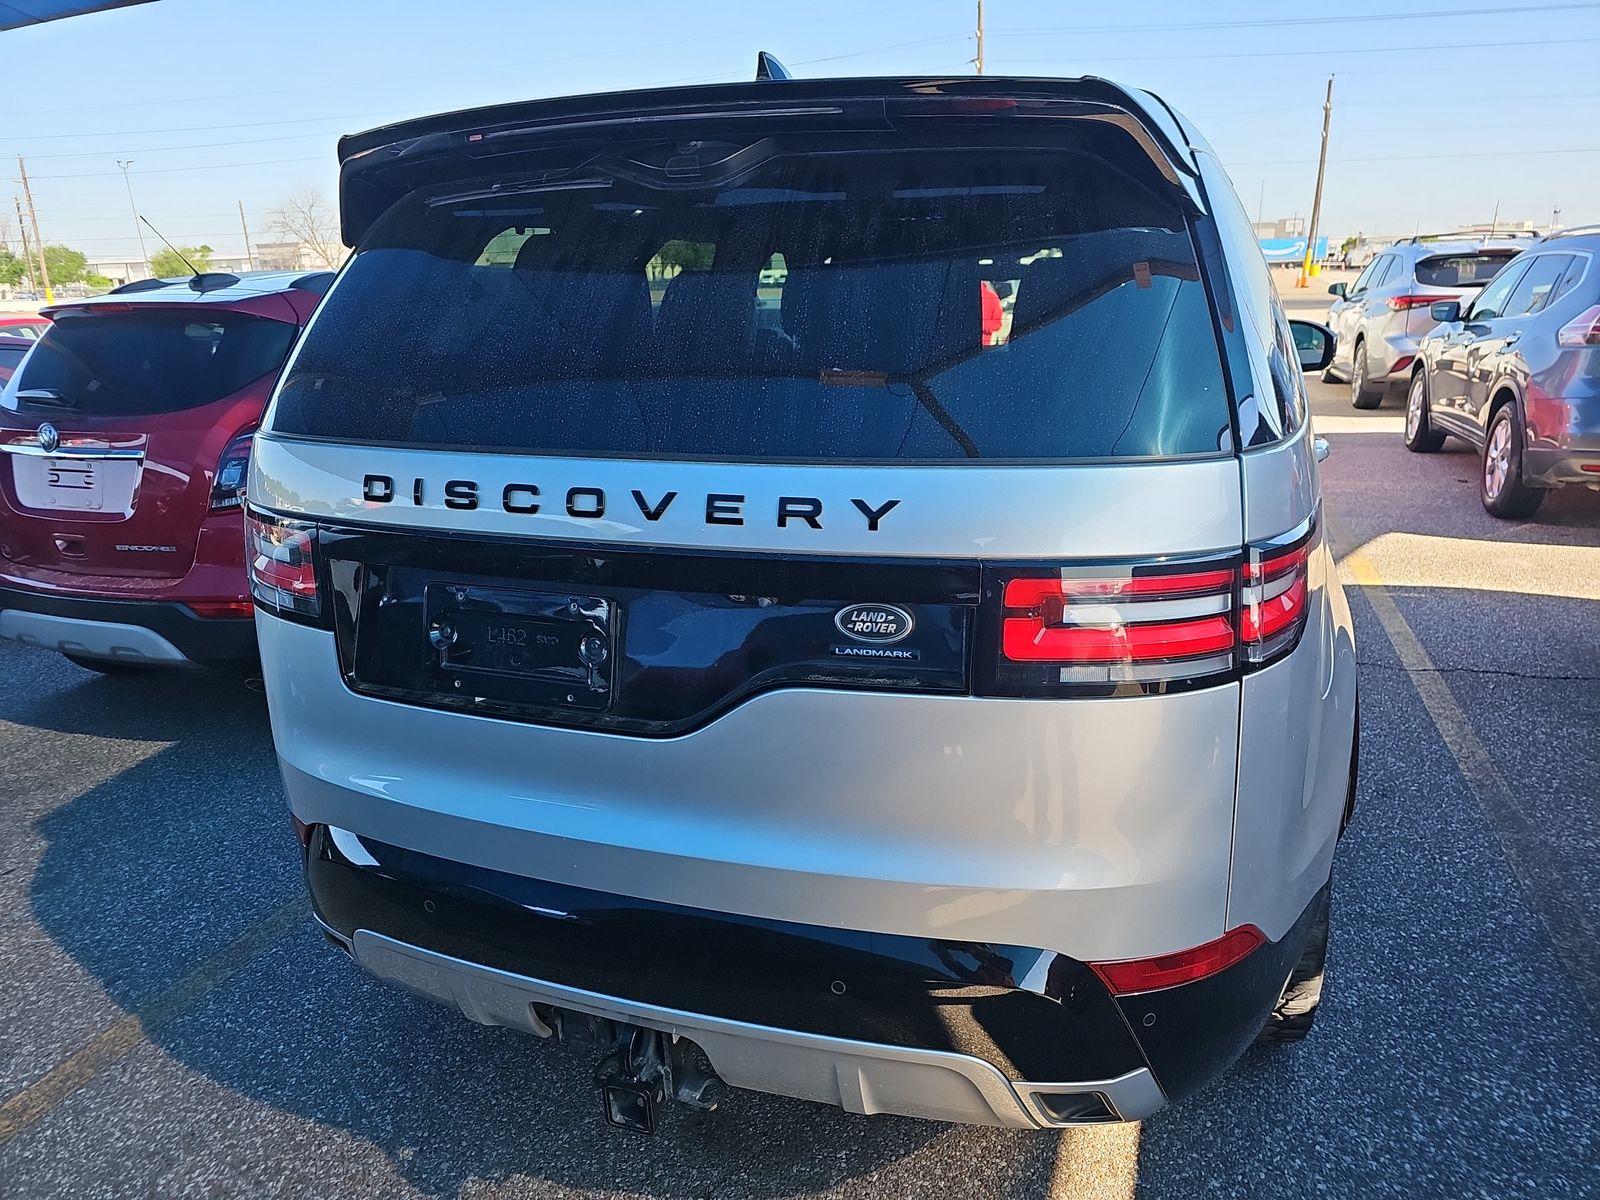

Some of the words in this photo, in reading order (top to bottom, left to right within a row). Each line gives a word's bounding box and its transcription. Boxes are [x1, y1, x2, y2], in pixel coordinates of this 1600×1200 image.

[363, 473, 902, 532] DISCOVERY
[115, 544, 177, 552] ENCORE
[851, 610, 887, 622] LAND
[853, 622, 897, 634] ROVER
[835, 647, 913, 659] LANDMARK
